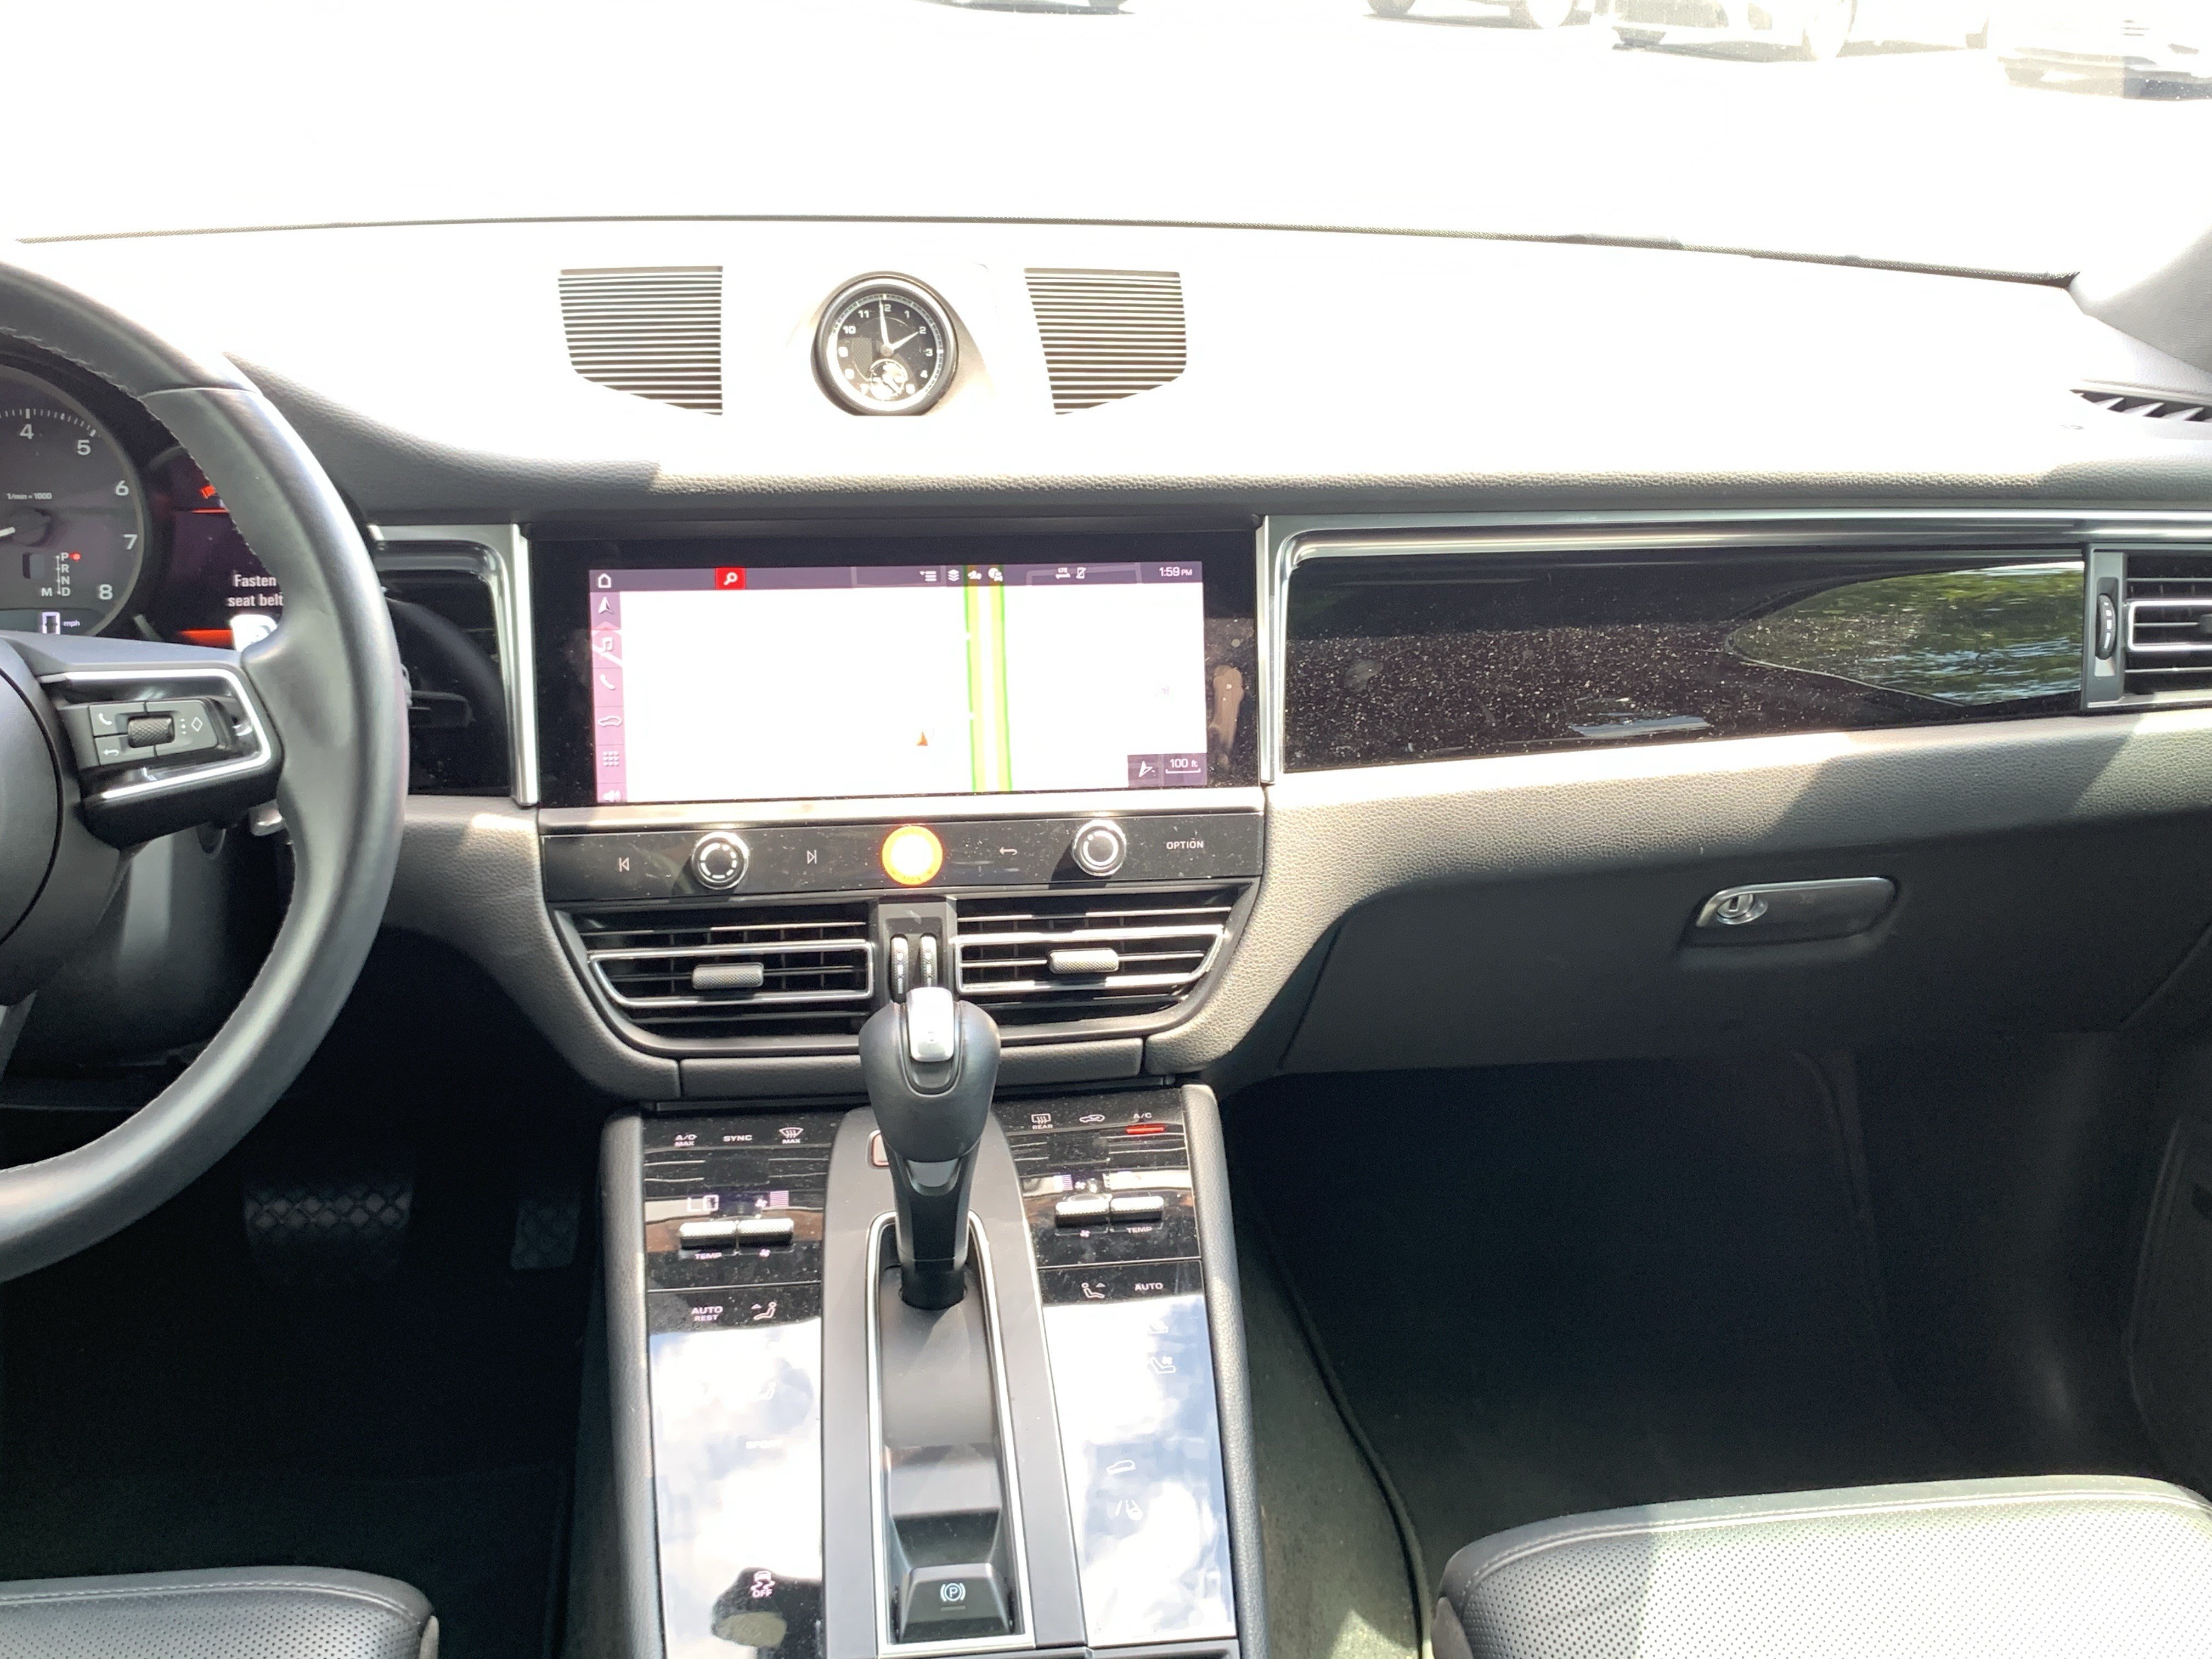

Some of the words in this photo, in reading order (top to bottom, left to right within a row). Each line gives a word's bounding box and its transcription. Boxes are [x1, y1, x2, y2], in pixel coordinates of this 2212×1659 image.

[858, 310, 869, 318] 11
[905, 310, 911, 318] 1
[842, 325, 856, 334] 10
[919, 326, 927, 335] 2
[925, 348, 933, 357] 3
[19, 423, 35, 439] 4
[76, 439, 92, 456] 5
[115, 480, 129, 496] 6
[122, 533, 138, 550] 7
[60, 552, 69, 561] P
[61, 564, 70, 573] R
[1159, 567, 1181, 577] 1:59
[61, 575, 70, 585] N
[234, 573, 276, 587] Fasten
[41, 587, 53, 597] M
[61, 586, 71, 596] D
[98, 583, 113, 600] 8
[227, 595, 256, 607] seat
[258, 593, 284, 606] belt
[1170, 758, 1189, 768] 100
[1166, 840, 1205, 850] OPTION
[723, 1134, 753, 1142] SYNC
[695, 1252, 722, 1260] TEMP
[1134, 1282, 1164, 1291] AUTO
[691, 1306, 724, 1315] AUTO
[752, 1588, 773, 1598] OFF
